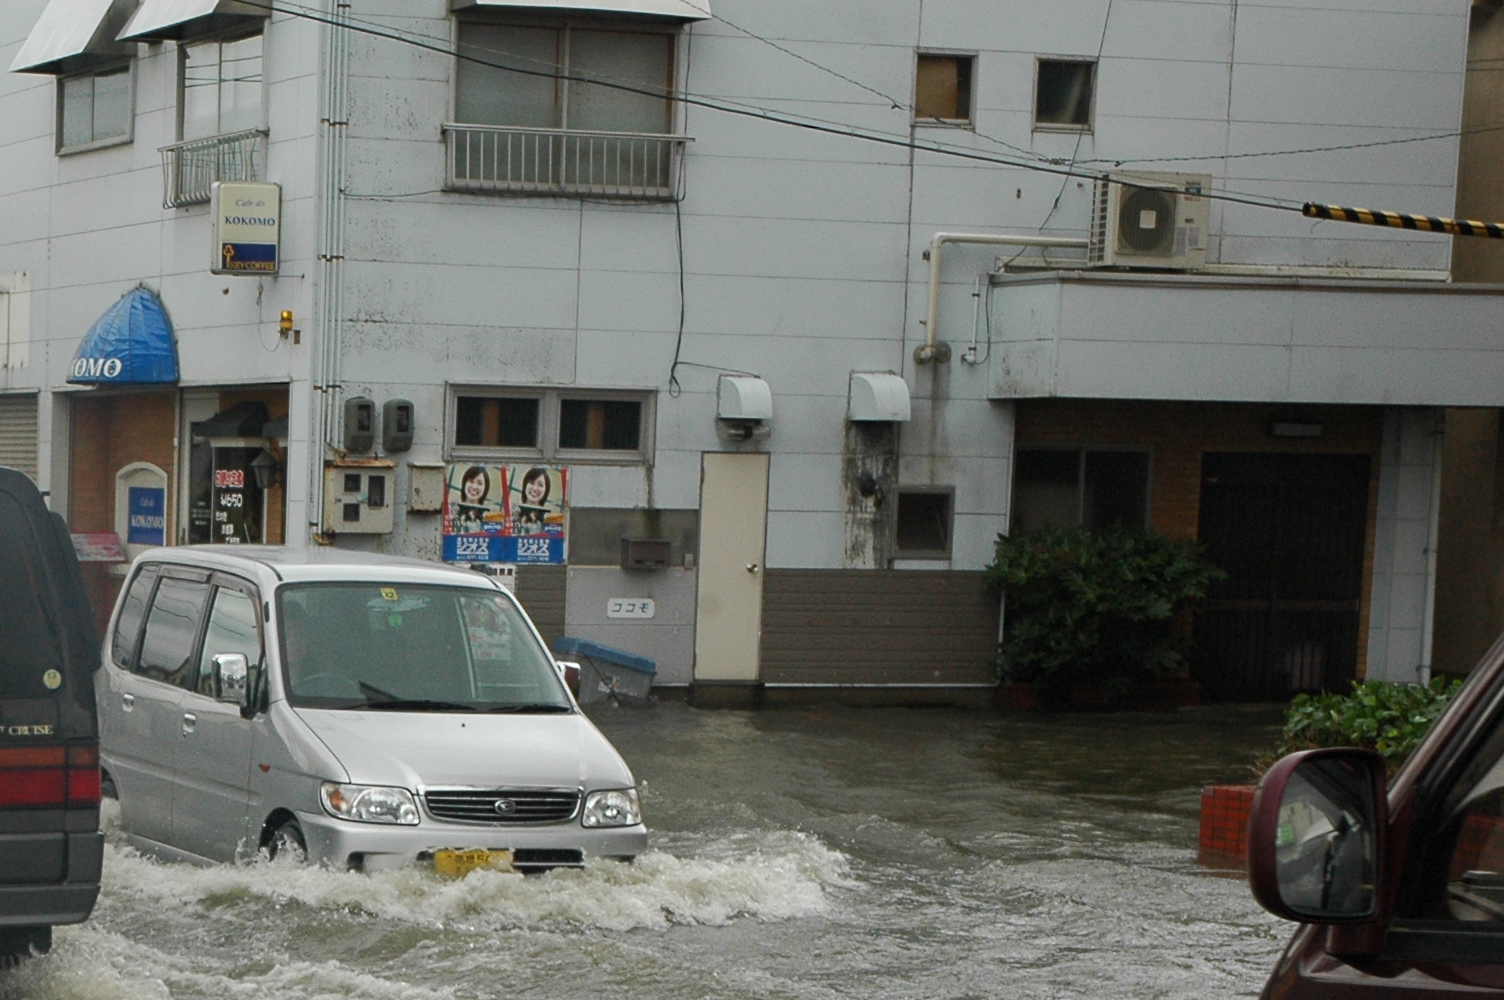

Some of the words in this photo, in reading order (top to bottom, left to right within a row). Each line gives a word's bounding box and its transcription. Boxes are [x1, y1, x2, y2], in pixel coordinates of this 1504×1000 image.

[225, 216, 276, 226] KOKOMO
[72, 357, 122, 377] OMO
[612, 602, 649, 614] ココモ
[8, 724, 54, 736] CRUISE
